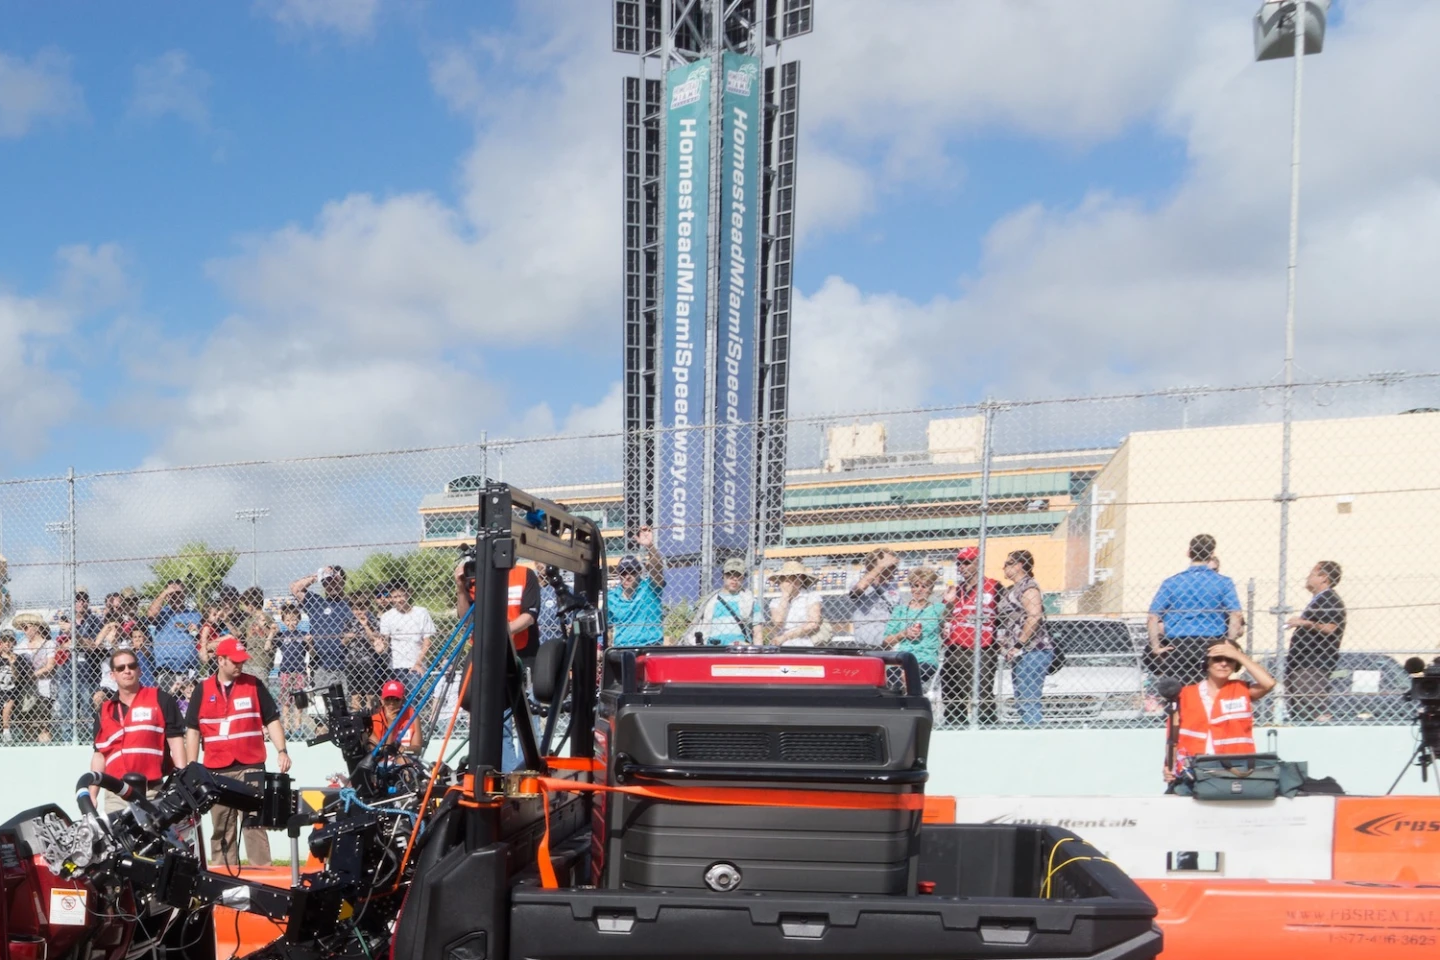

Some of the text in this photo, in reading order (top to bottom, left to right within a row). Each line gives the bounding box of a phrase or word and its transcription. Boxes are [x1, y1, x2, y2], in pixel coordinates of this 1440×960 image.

[672, 118, 697, 542] HomesteadMiamiSpeedway.com
[722, 107, 748, 535] HomesteadMiamiSpeedway.com
[1059, 818, 1137, 828] Rentals
[1394, 821, 1440, 832] PBS
